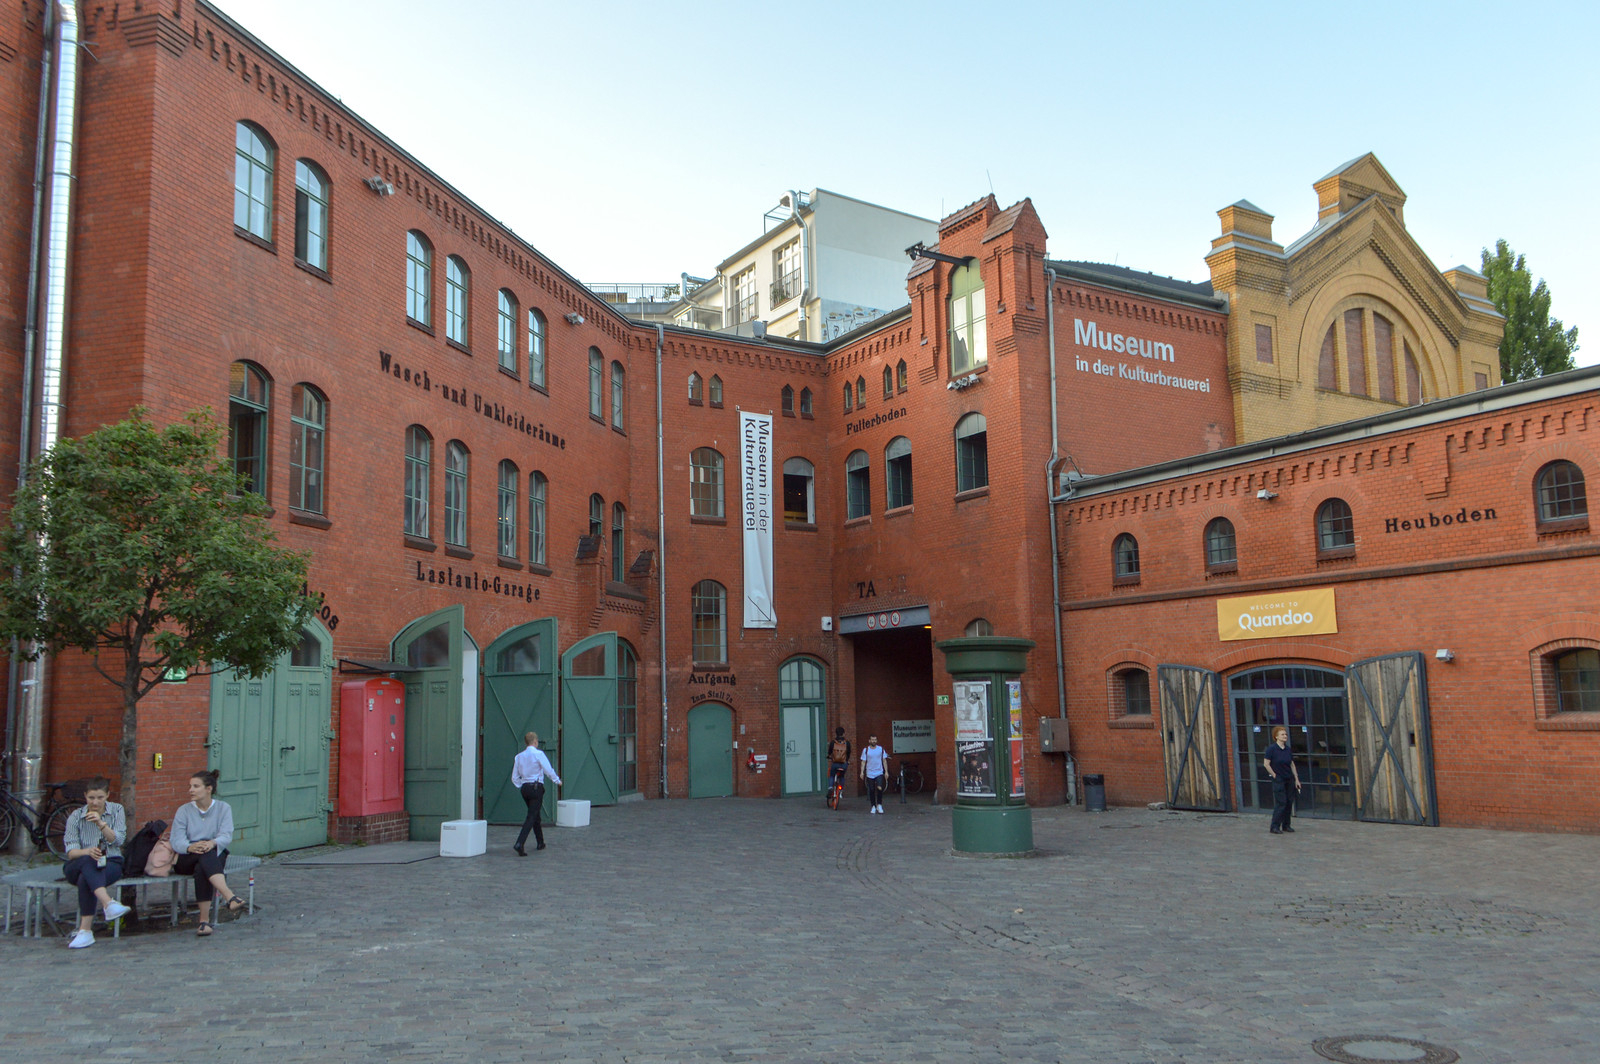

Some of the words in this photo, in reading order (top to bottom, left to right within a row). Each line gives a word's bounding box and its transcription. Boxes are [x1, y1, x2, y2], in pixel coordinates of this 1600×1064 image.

[1074, 318, 1175, 363] Museum
[1075, 355, 1089, 372] in
[1092, 359, 1115, 376] der
[1118, 362, 1210, 393] Kulturbrauerei
[473, 393, 566, 450] Umkleideräume
[758, 419, 770, 488] Museum
[744, 418, 758, 531] Kulturbrauerei
[759, 493, 770, 506] in
[759, 509, 770, 534] der
[1384, 507, 1498, 534] Heuboden
[1249, 602, 1285, 611] WELCOME
[1238, 609, 1314, 633] Quandoo
[688, 672, 737, 687] Aufgang
